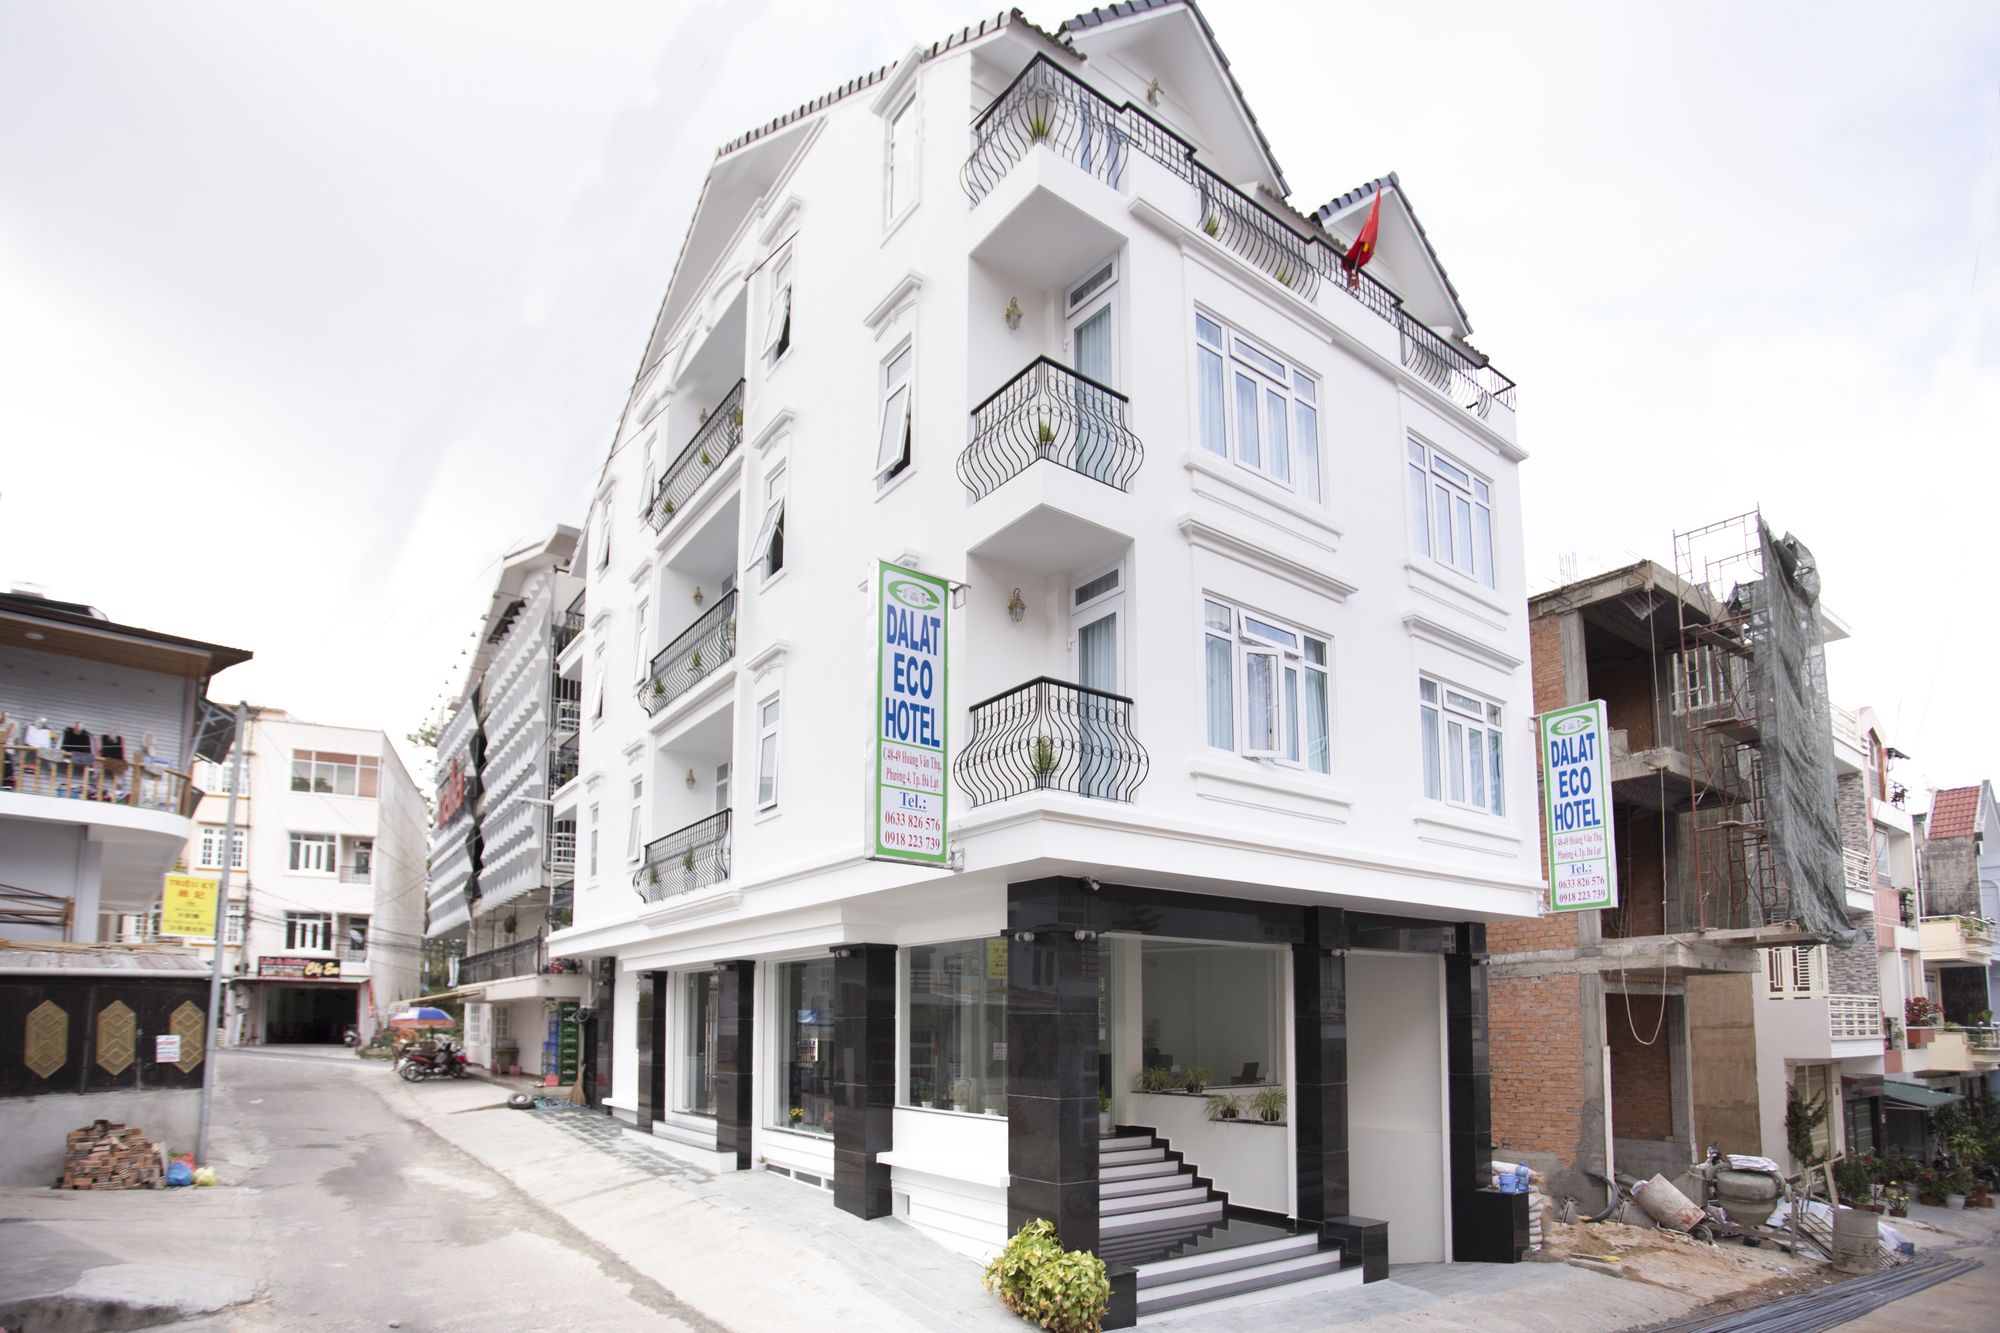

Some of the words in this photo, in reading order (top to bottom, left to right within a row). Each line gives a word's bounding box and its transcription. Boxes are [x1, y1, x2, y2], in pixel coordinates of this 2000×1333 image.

[886, 603, 941, 656] DALAT
[894, 652, 933, 700] ECO
[885, 696, 940, 748] HOTEL
[1551, 732, 1595, 768] DALAT
[1559, 766, 1592, 798] ECO
[900, 791, 926, 810] Tel.:
[885, 811, 905, 826] 0633
[908, 814, 923, 829] 826
[925, 817, 940, 832] 576
[1554, 798, 1600, 832] HOTEL
[885, 831, 905, 847] 0918
[908, 833, 923, 848] 223
[925, 836, 940, 851] 739
[1558, 878, 1575, 890] 0633
[1576, 877, 1590, 887] 826
[1592, 874, 1605, 887] 576
[1569, 863, 1592, 875] Tel.:
[1559, 891, 1576, 902] 0918
[1577, 890, 1591, 901] 223
[1592, 888, 1606, 900] 739
